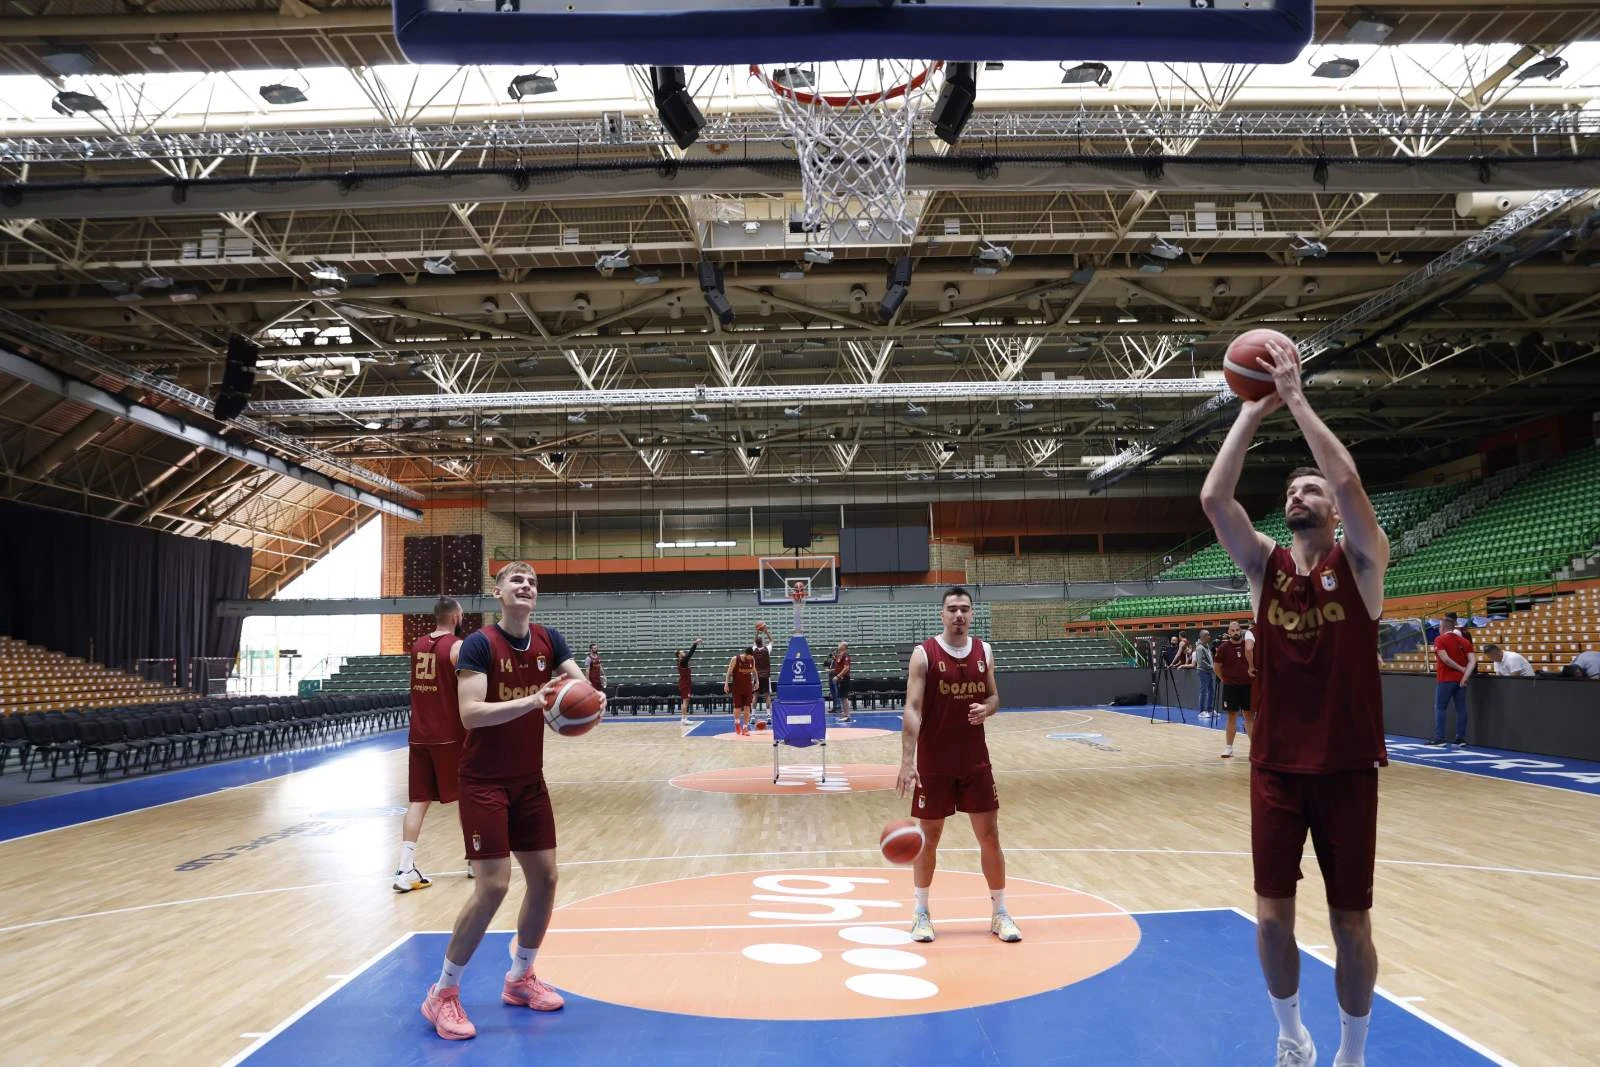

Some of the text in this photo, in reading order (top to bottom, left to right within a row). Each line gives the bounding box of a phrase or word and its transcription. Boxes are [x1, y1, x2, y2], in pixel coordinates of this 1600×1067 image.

[415, 651, 437, 680] 20
[500, 657, 512, 673] 14
[939, 679, 986, 695] bosna
